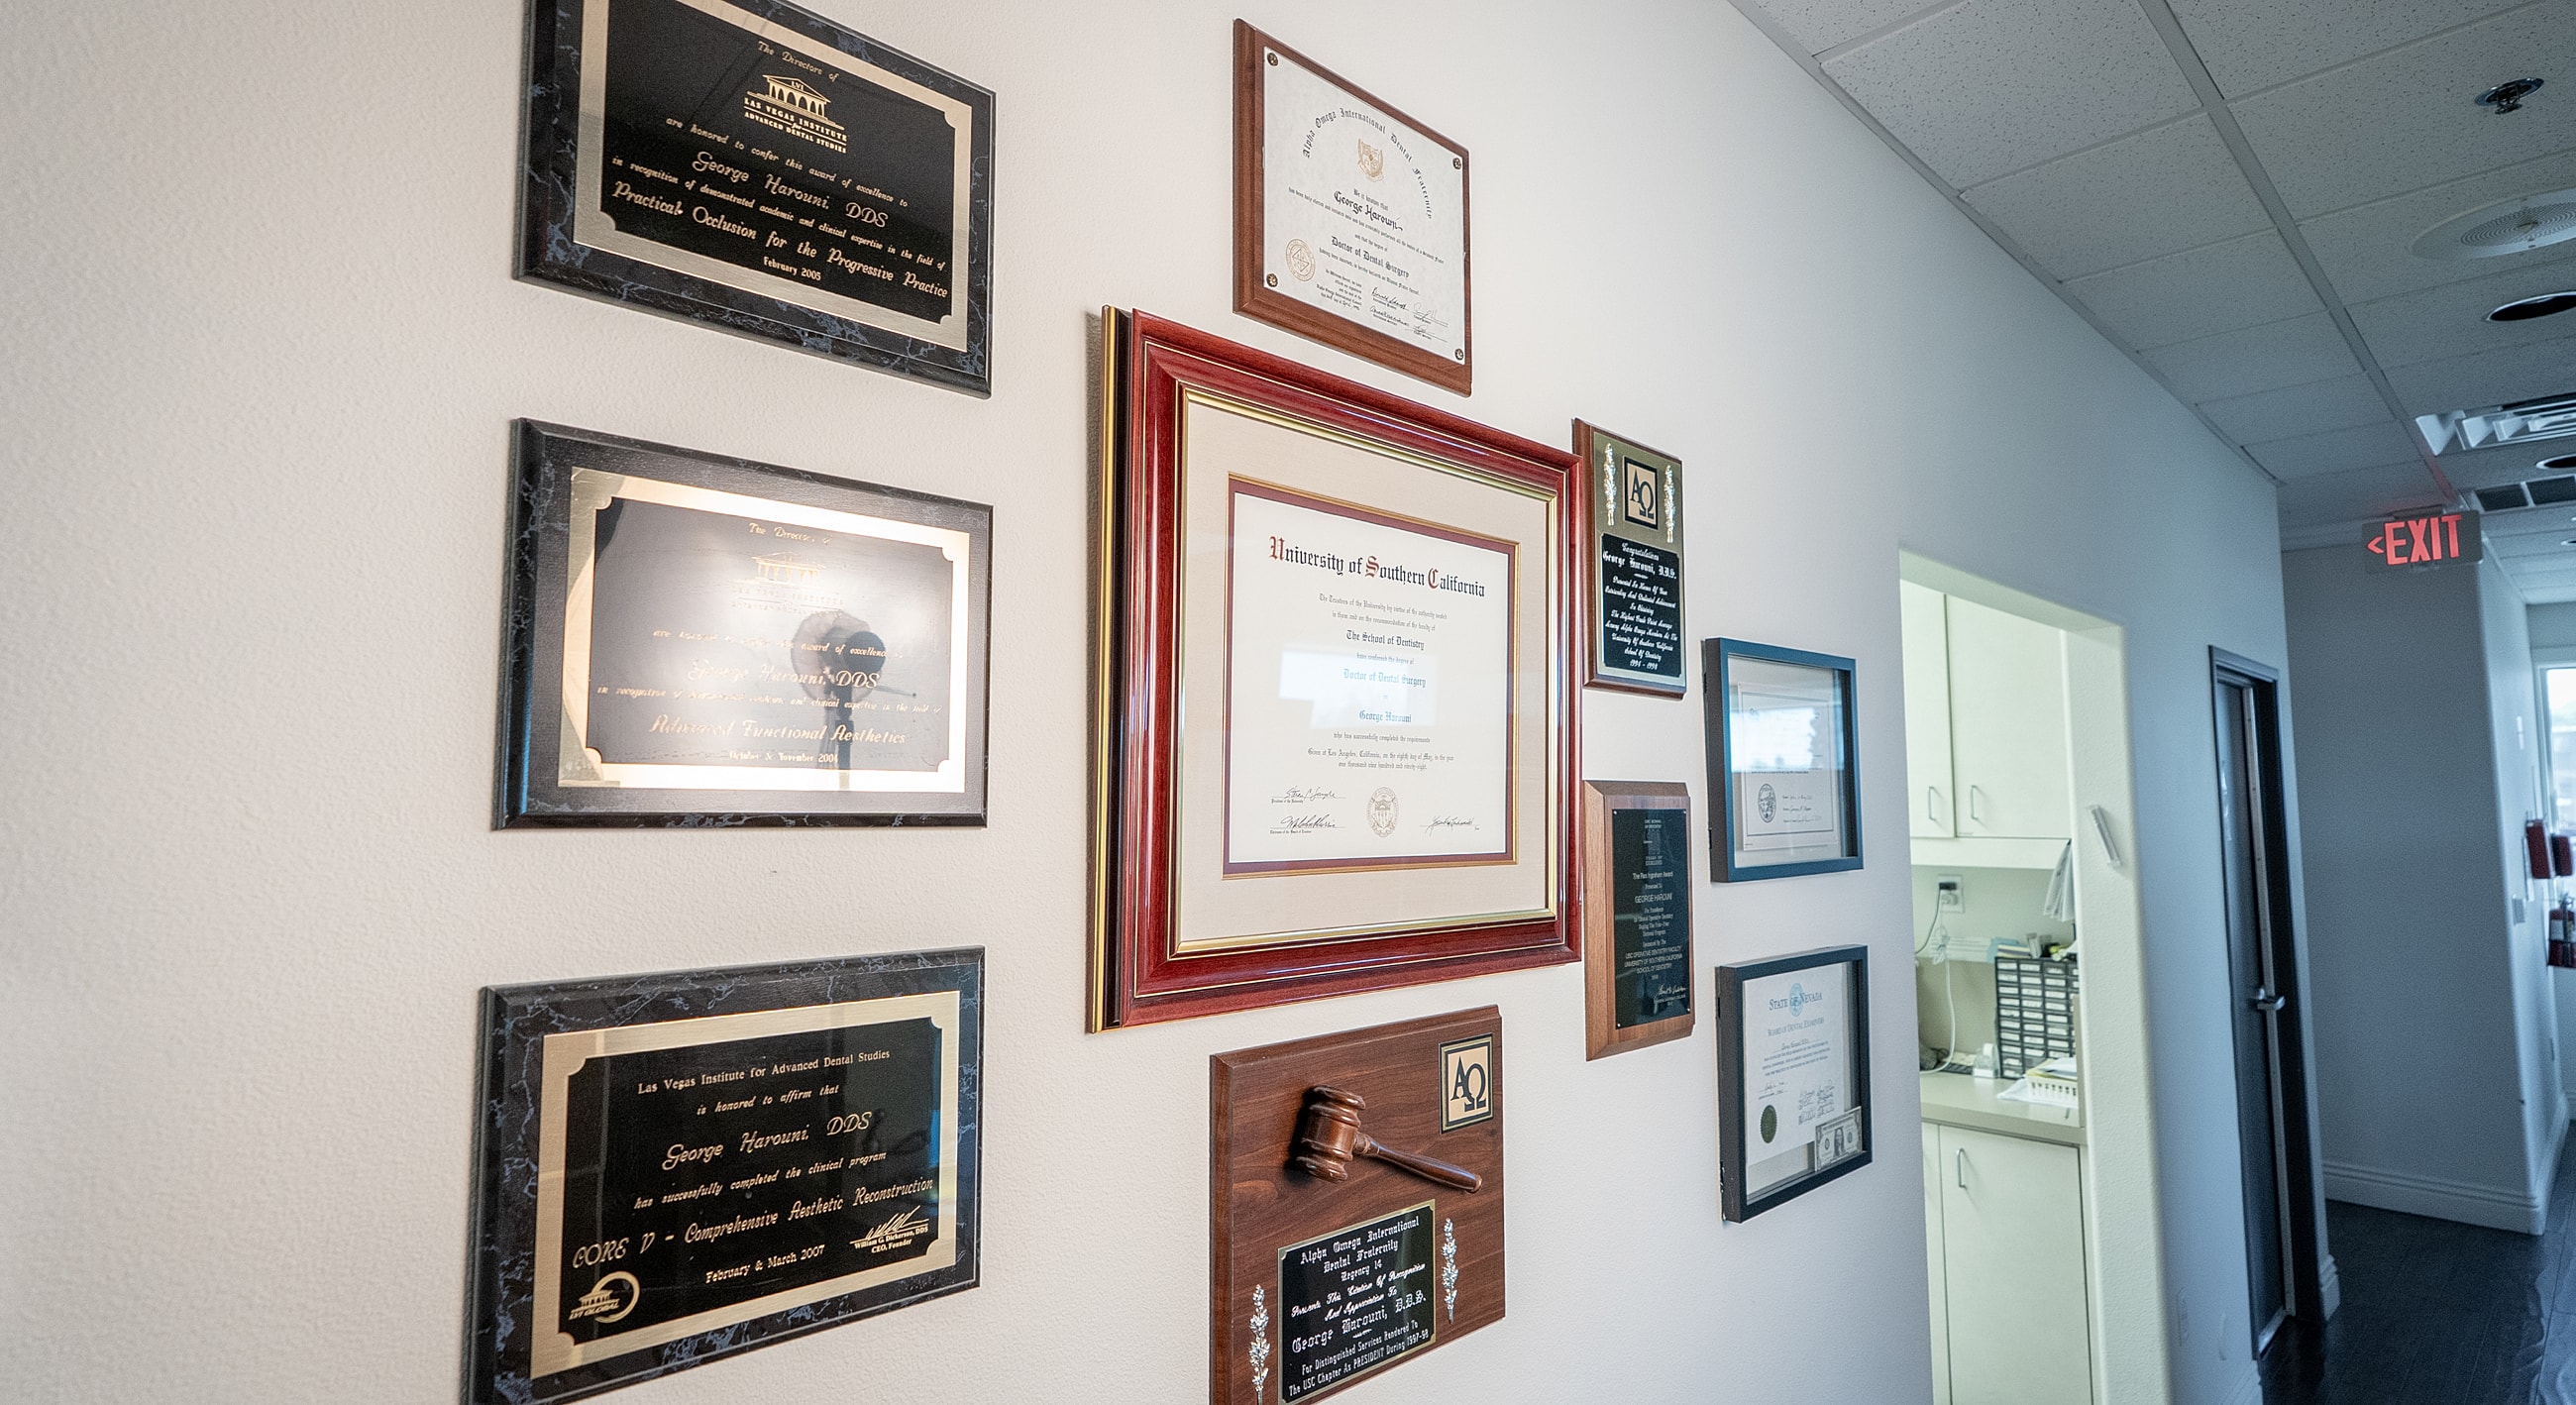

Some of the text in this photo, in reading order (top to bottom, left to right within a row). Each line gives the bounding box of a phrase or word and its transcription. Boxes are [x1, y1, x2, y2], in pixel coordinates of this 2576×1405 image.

[758, 41, 775, 55] The
[783, 52, 822, 75] Directors
[745, 98, 847, 142] LAS VEGAS INSTITUTE
[745, 112, 847, 154] ADVANCED DENTAL STUDIES
[1302, 130, 1316, 159] Alpha
[1316, 111, 1337, 129] Omega
[1340, 107, 1387, 135] International
[1390, 133, 1413, 162] Dental
[666, 117, 908, 207] are honored to confer this award of excellence to
[692, 151, 889, 228] George Harouni, DDS
[1334, 190, 1363, 215] George
[612, 156, 945, 271] in recognition of demonstrated academic and clinical expertise in the field of
[612, 180, 948, 297] Practical Occlusion for the Progressive Practice
[1331, 235, 1410, 280] Doctor of Dental Surgery
[763, 257, 821, 281] February 2005
[1603, 551, 1625, 568] George
[2384, 515, 2463, 566] EXIT
[1268, 535, 1486, 597] University of Southern California
[1345, 629, 1425, 651] The School of Dentistry
[836, 670, 880, 689] DDS
[1343, 668, 1366, 681] Doctor
[1369, 672, 1376, 682] of
[830, 725, 906, 744] Aesthetics
[1359, 709, 1412, 723] George Harouni
[638, 1049, 891, 1094] Las Vegas Institute for Advanced Dental Studies
[697, 1084, 840, 1116] is honored to affirm that
[662, 1111, 872, 1171] George Harouni, DDS
[634, 1151, 887, 1209] has successfully completed the clinical program
[573, 1237, 630, 1268] CORE
[684, 1209, 779, 1244] Comprehensive
[788, 1194, 844, 1221] Aesthetic
[852, 1176, 933, 1207] Reconstruction
[1300, 1215, 1420, 1264] Alpha Omega International
[705, 1244, 825, 1284] February & March 2007
[1324, 1240, 1399, 1273] Dental Fraternity
[1292, 1289, 1427, 1353] George Harouni, D.D.S.
[1288, 1385, 1300, 1397] The
[1303, 1376, 1316, 1391] USC
[1318, 1367, 1342, 1383] Chapter
[1343, 1362, 1351, 1373] As
[1353, 1348, 1385, 1369] PRESIDENT
[1386, 1341, 1407, 1355] During
[1302, 1320, 1419, 1376] For Distinguished Services Rendered To
